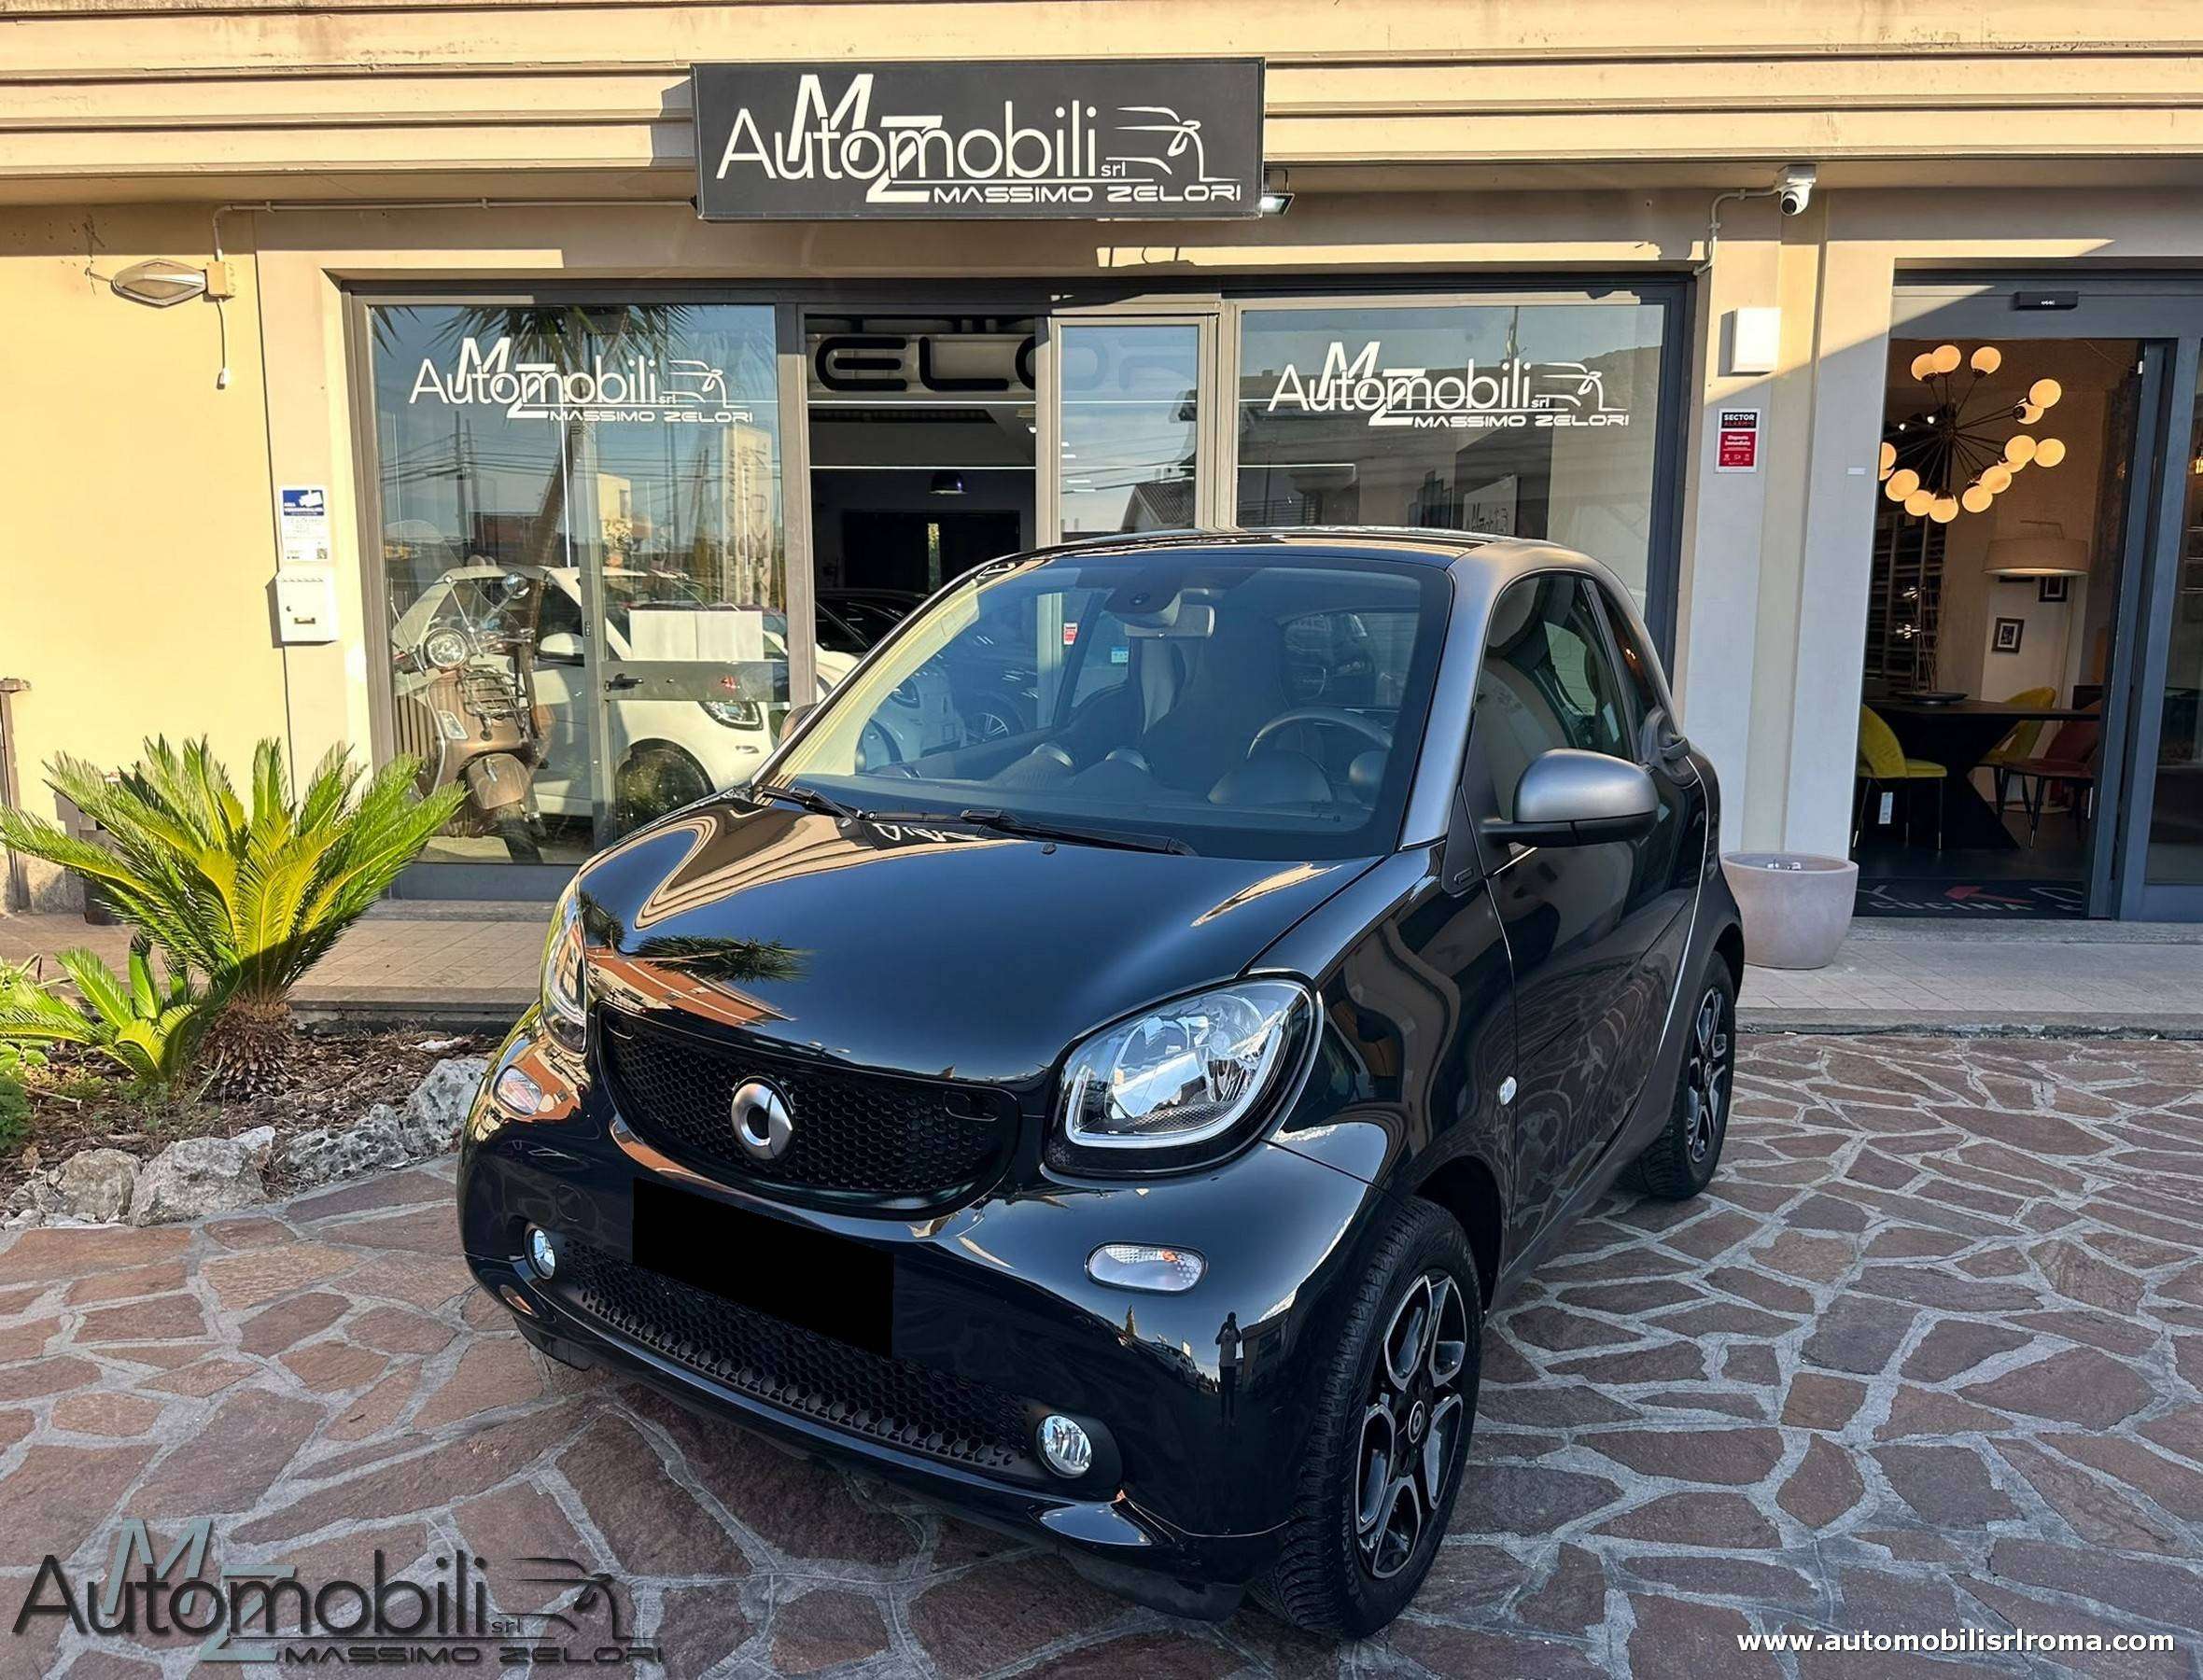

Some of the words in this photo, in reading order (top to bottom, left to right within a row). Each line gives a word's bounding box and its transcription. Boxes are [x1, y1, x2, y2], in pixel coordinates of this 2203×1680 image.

[716, 99, 1097, 179] Automobili
[1101, 161, 1126, 176] srl
[933, 184, 1093, 203] MASSIMO
[1107, 184, 1242, 203] ZELORI
[408, 355, 657, 404] Automobili
[658, 393, 677, 404] srl
[1268, 358, 1532, 412] Automobili
[1531, 397, 1550, 408] srl
[549, 410, 655, 423] MASSIMO
[664, 410, 753, 424] ZELORI
[1414, 414, 1527, 429] MASSIMO
[1535, 413, 1630, 427] ZELORI
